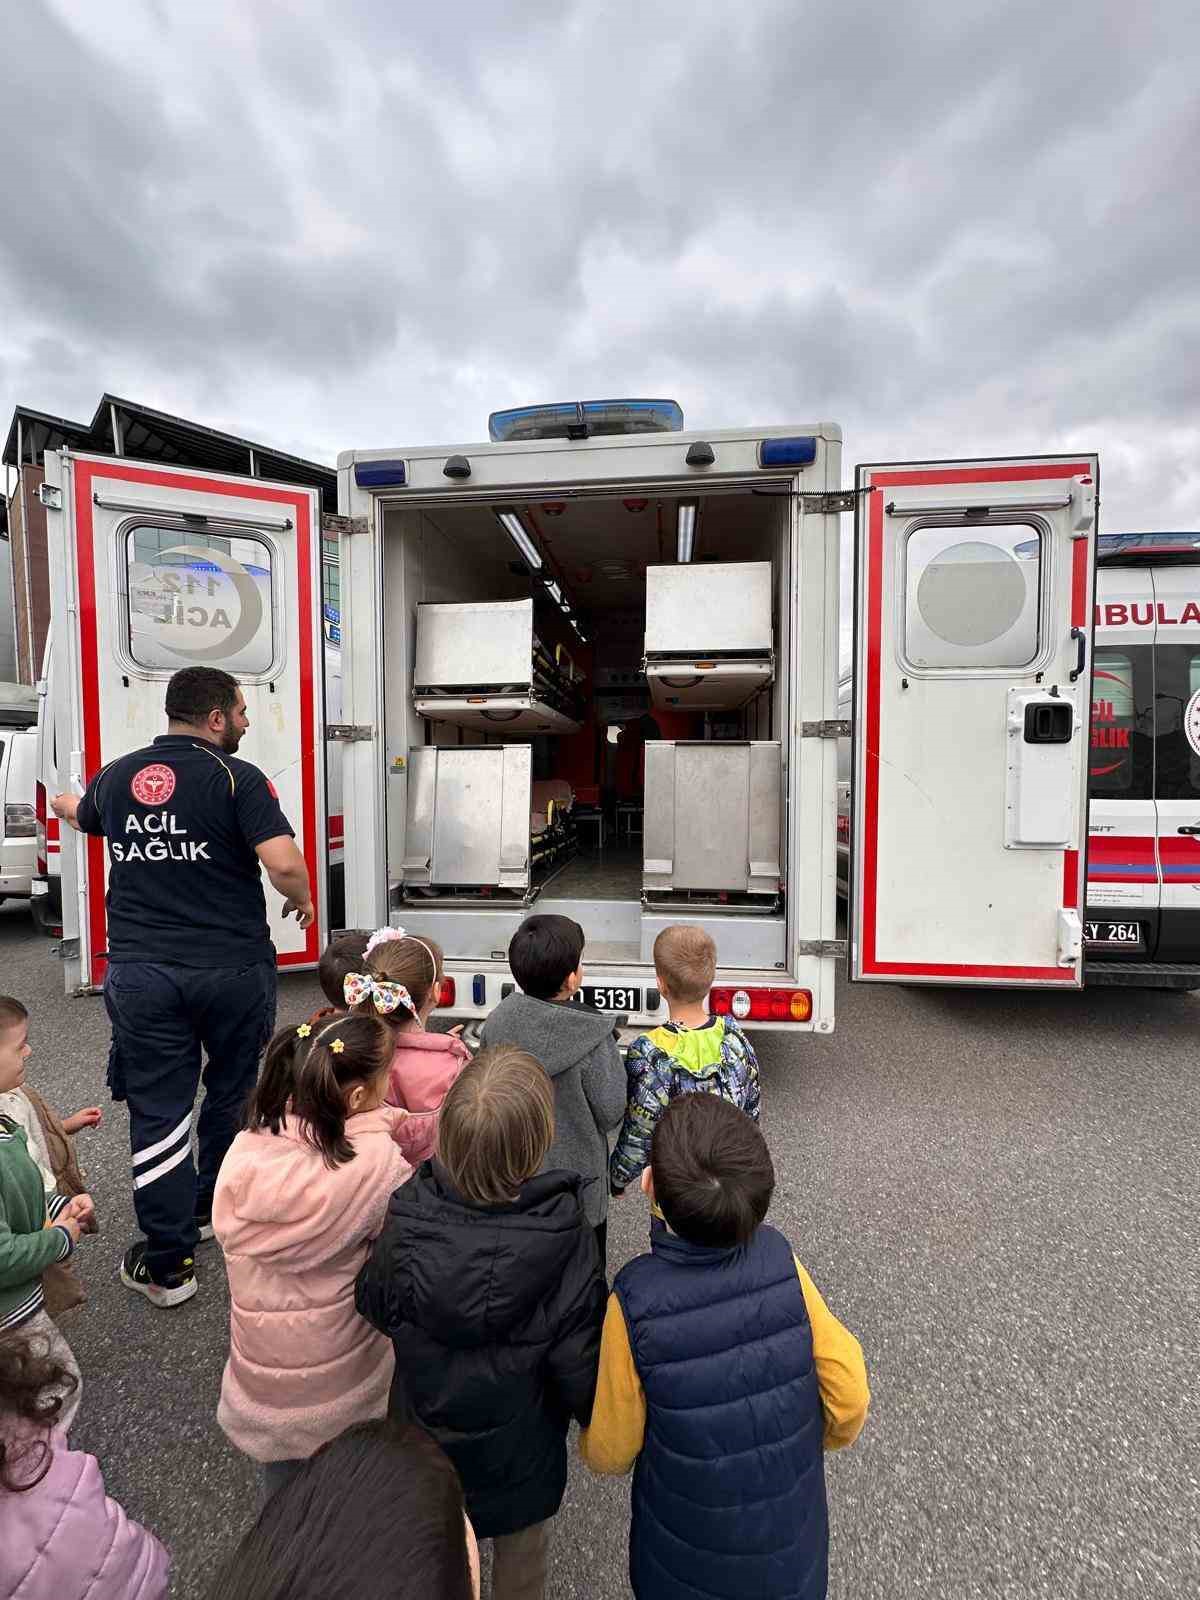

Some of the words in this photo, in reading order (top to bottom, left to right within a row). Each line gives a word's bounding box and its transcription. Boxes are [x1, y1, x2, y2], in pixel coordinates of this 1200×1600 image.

[125, 811, 188, 835] ACİL
[112, 837, 212, 862] SAĞLIK
[1108, 924, 1137, 941] 264
[594, 988, 635, 1009] 5131
